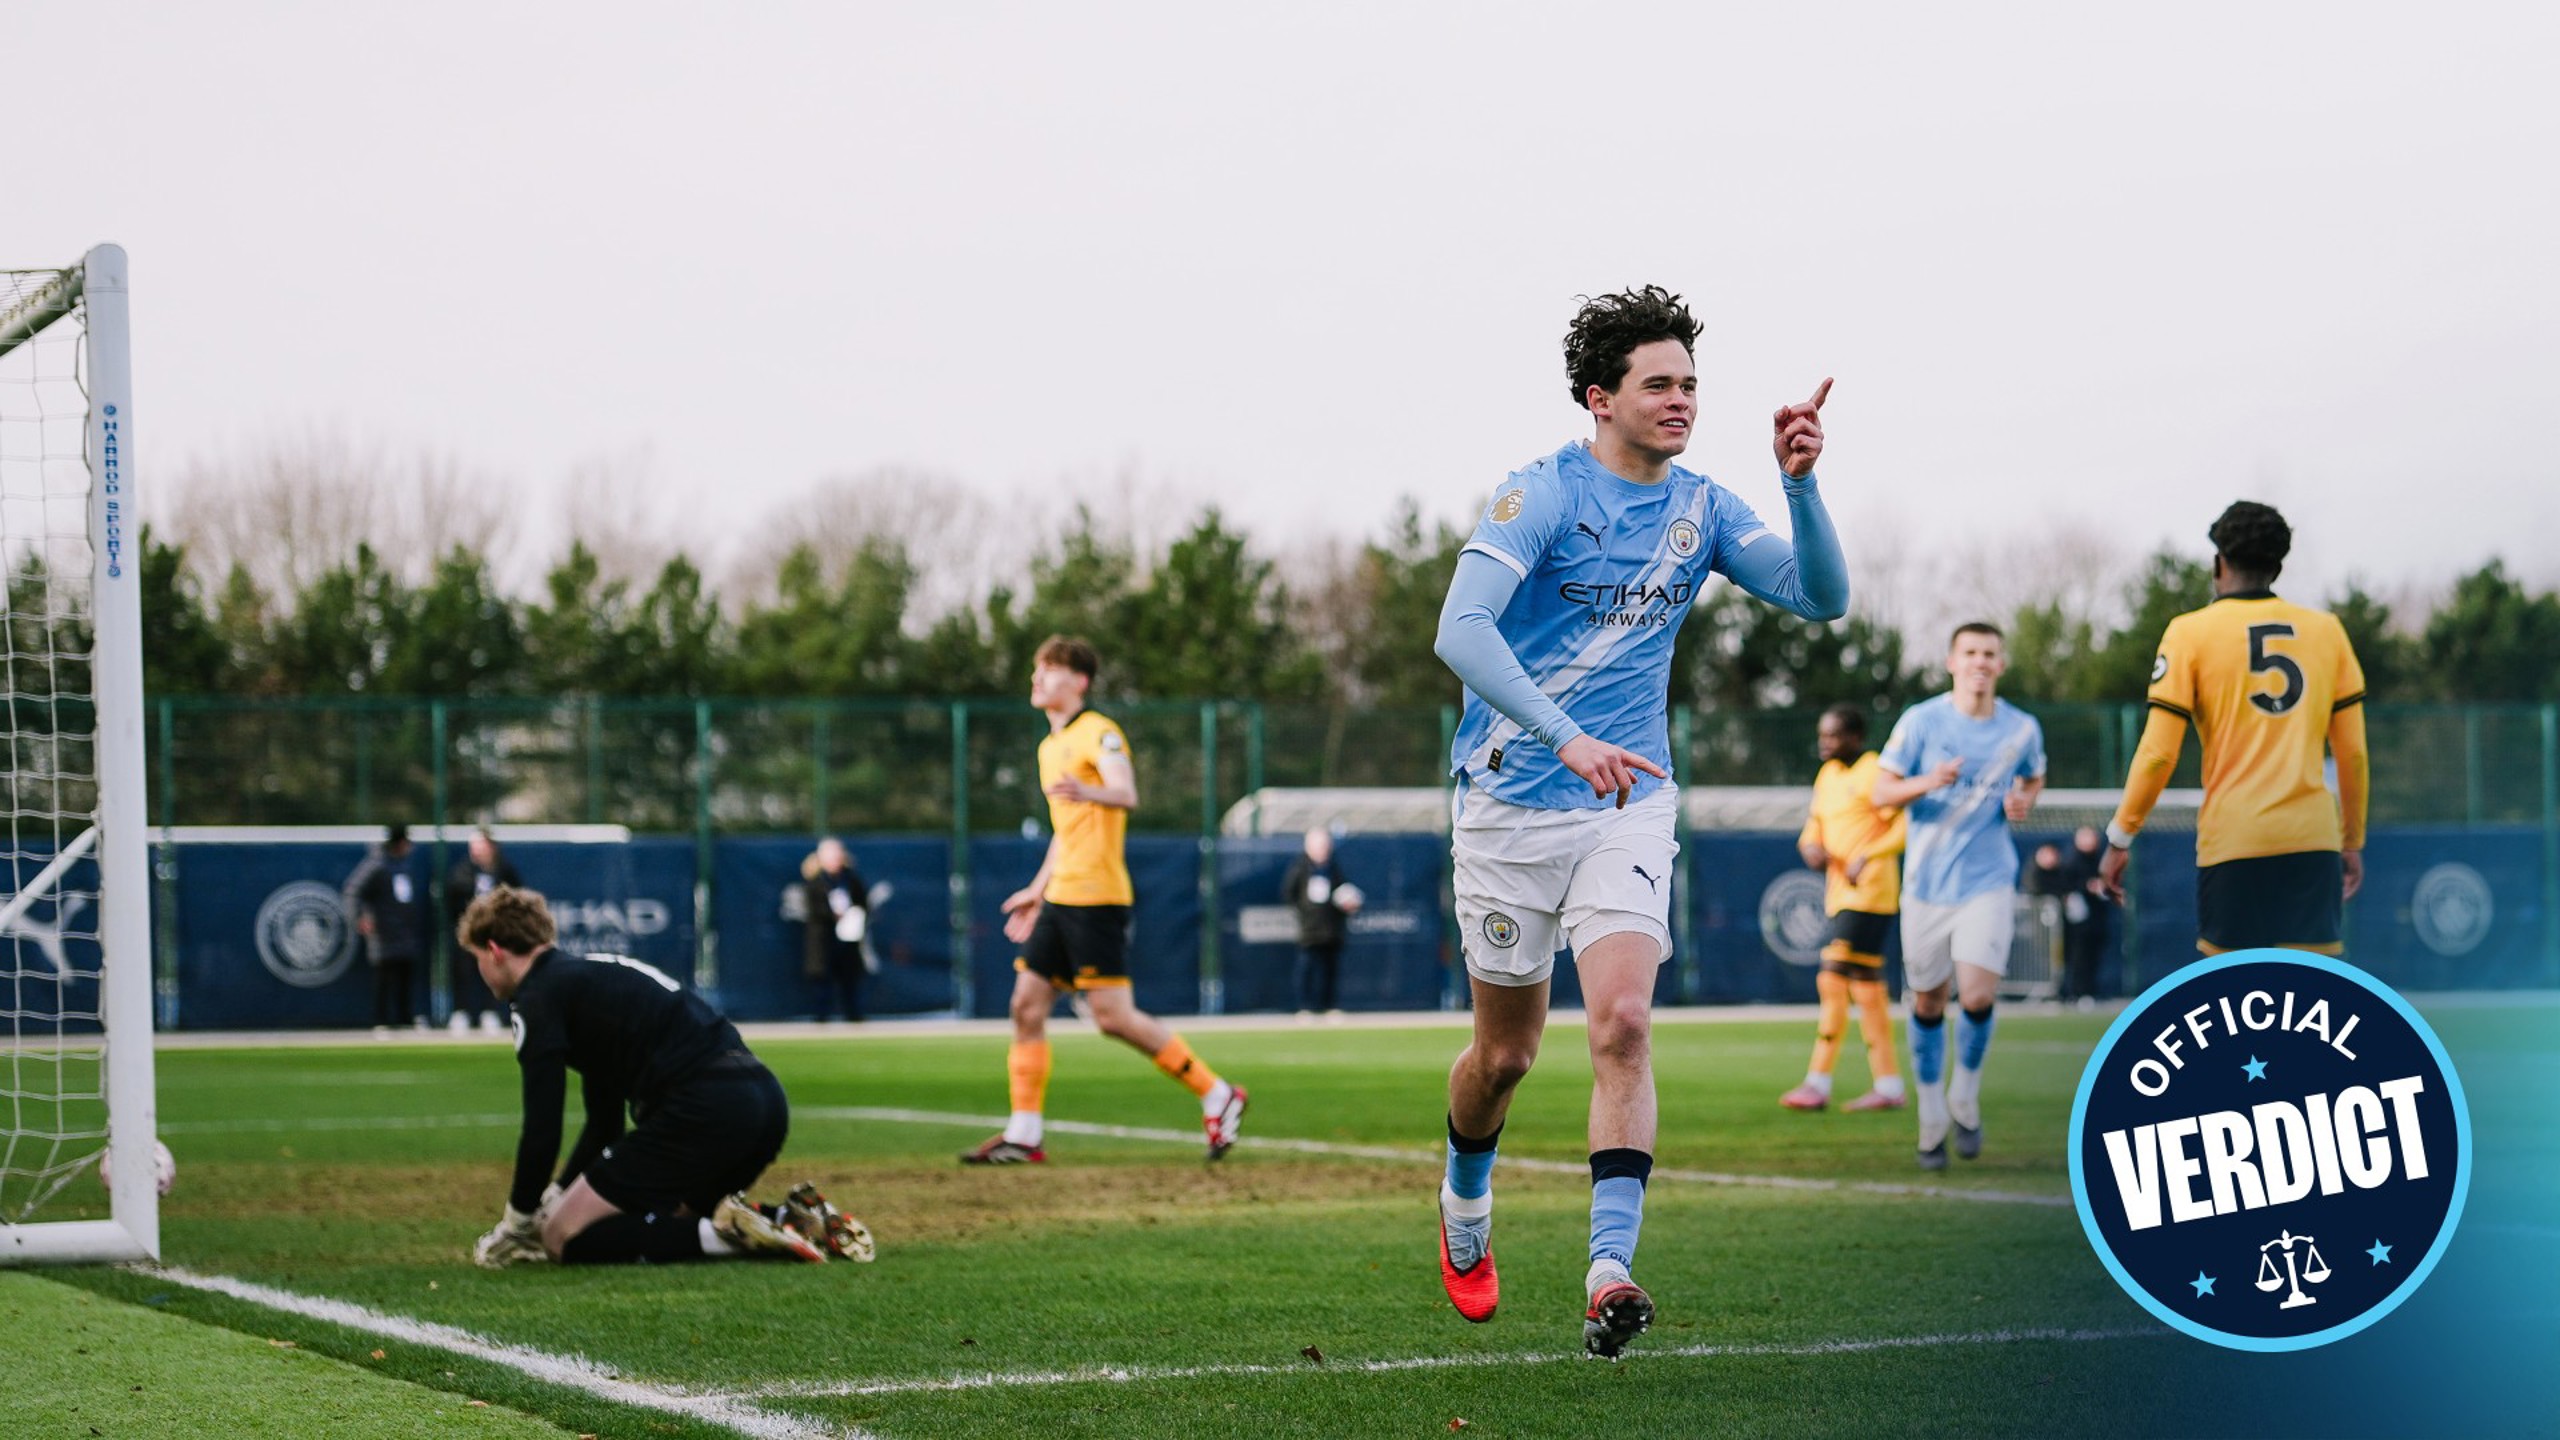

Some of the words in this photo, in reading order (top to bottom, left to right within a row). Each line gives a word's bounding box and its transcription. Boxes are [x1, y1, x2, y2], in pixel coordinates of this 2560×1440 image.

[1559, 582, 1691, 605] ETIHAD
[1586, 612, 1668, 627] AIRWAYS
[2246, 623, 2305, 715] 5
